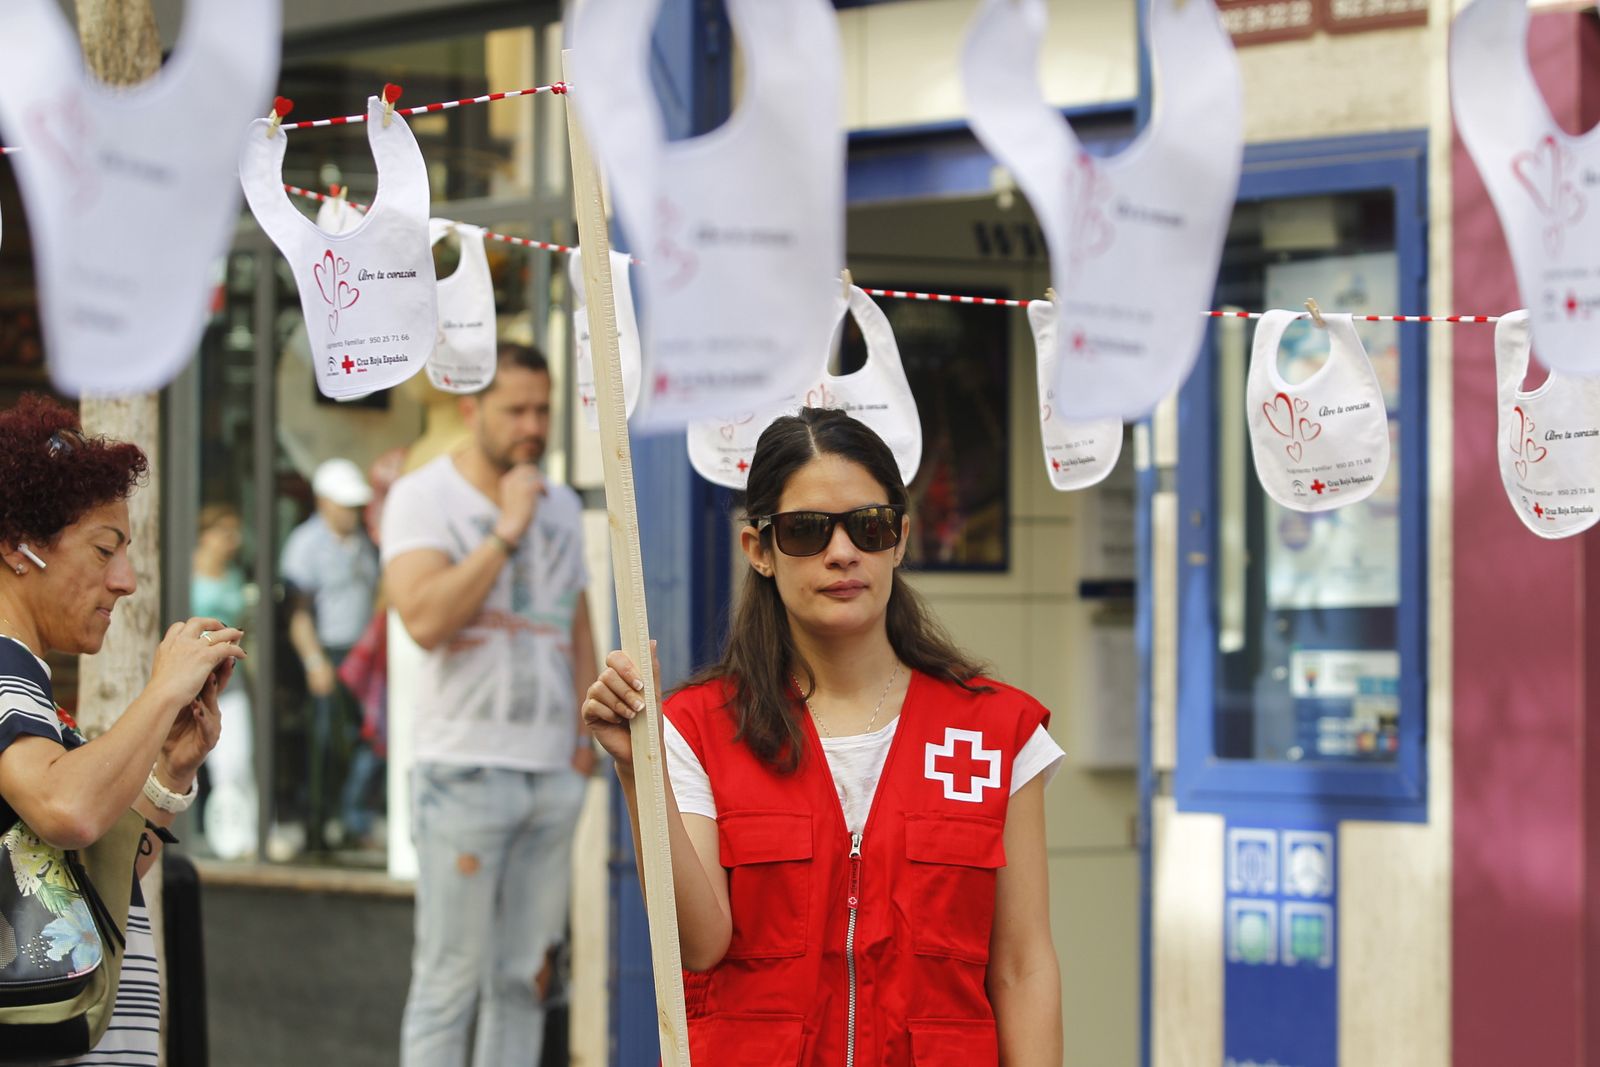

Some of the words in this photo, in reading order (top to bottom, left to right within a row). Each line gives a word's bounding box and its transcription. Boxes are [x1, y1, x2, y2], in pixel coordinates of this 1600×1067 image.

[377, 269, 385, 280] tu
[369, 336, 382, 344] 950
[391, 334, 399, 342] 71
[356, 357, 369, 366] Cruz
[370, 356, 383, 366] Roja
[383, 354, 409, 365] Española
[1340, 478, 1351, 486] Roja
[1352, 475, 1374, 485] Española
[1545, 507, 1557, 515] Cruz
[1557, 506, 1570, 516] Roja
[1570, 505, 1594, 515] Española
